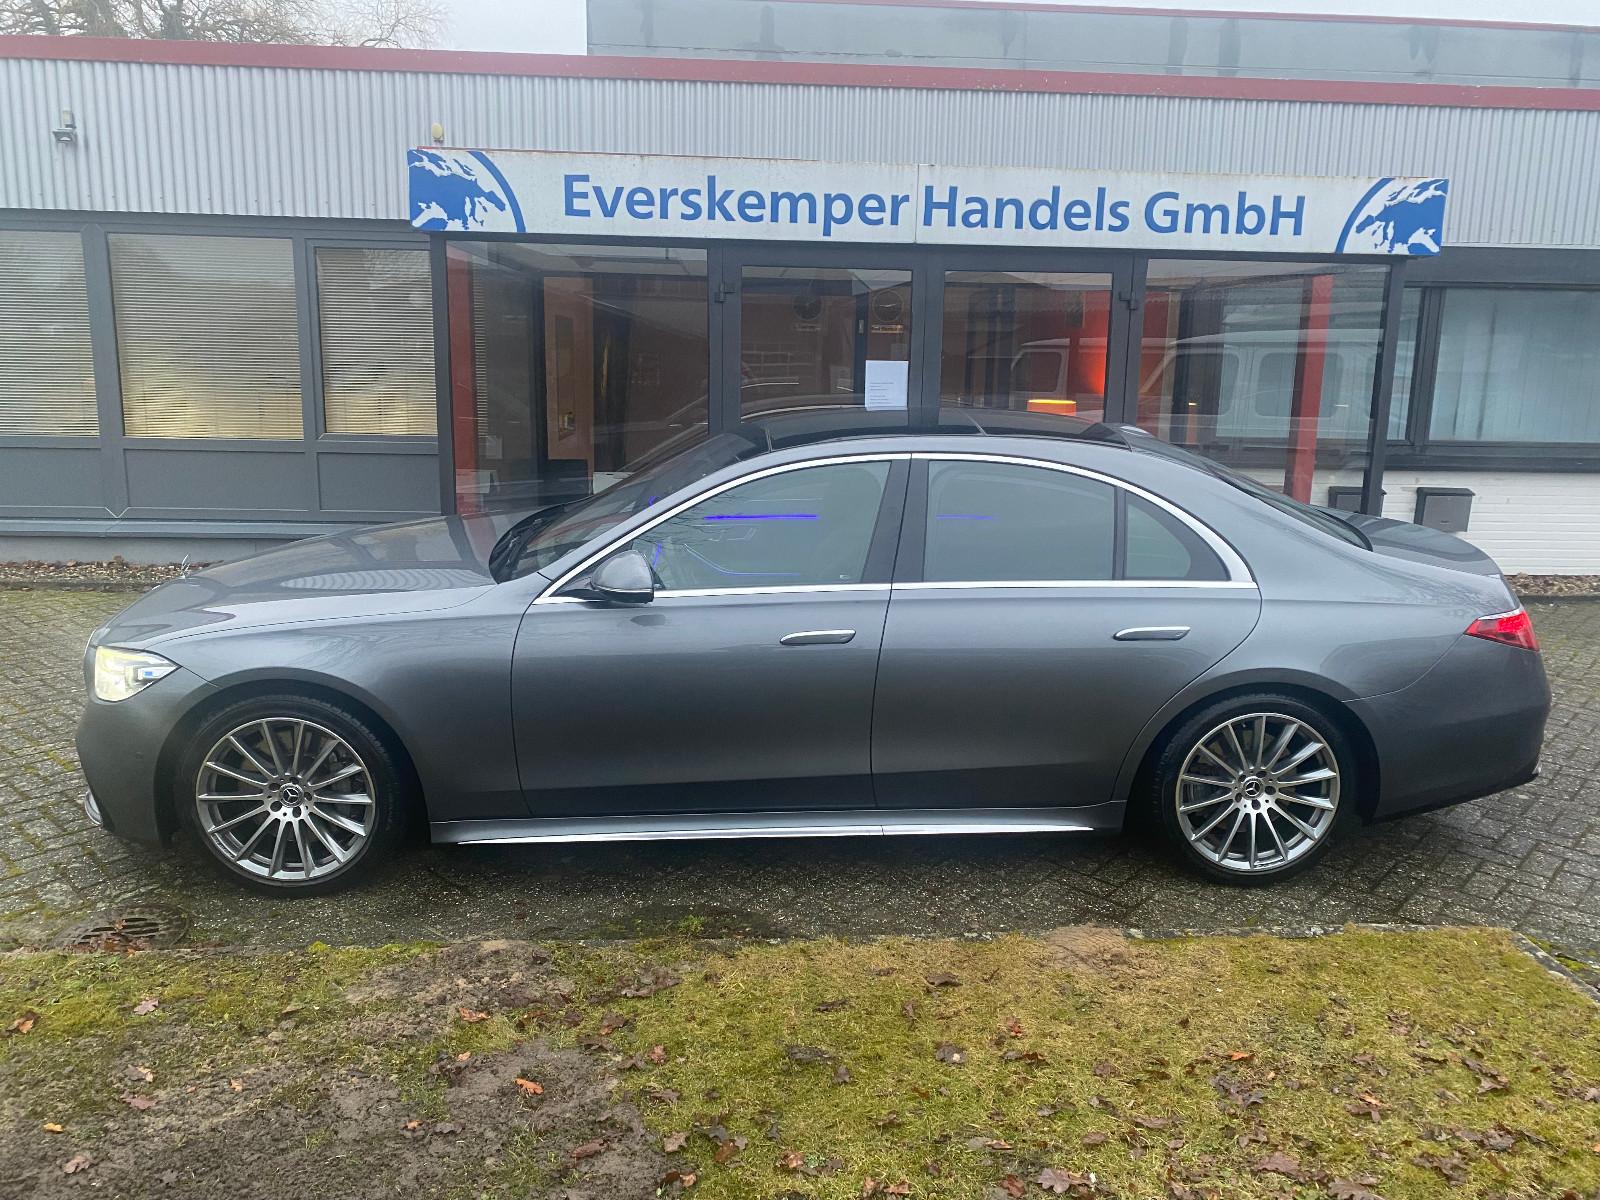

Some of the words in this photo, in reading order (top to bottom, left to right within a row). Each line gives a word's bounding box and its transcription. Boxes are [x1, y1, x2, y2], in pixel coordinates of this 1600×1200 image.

[564, 174, 910, 238] Everskemper
[922, 185, 1130, 232] Handels
[1143, 191, 1306, 237] GmbH
